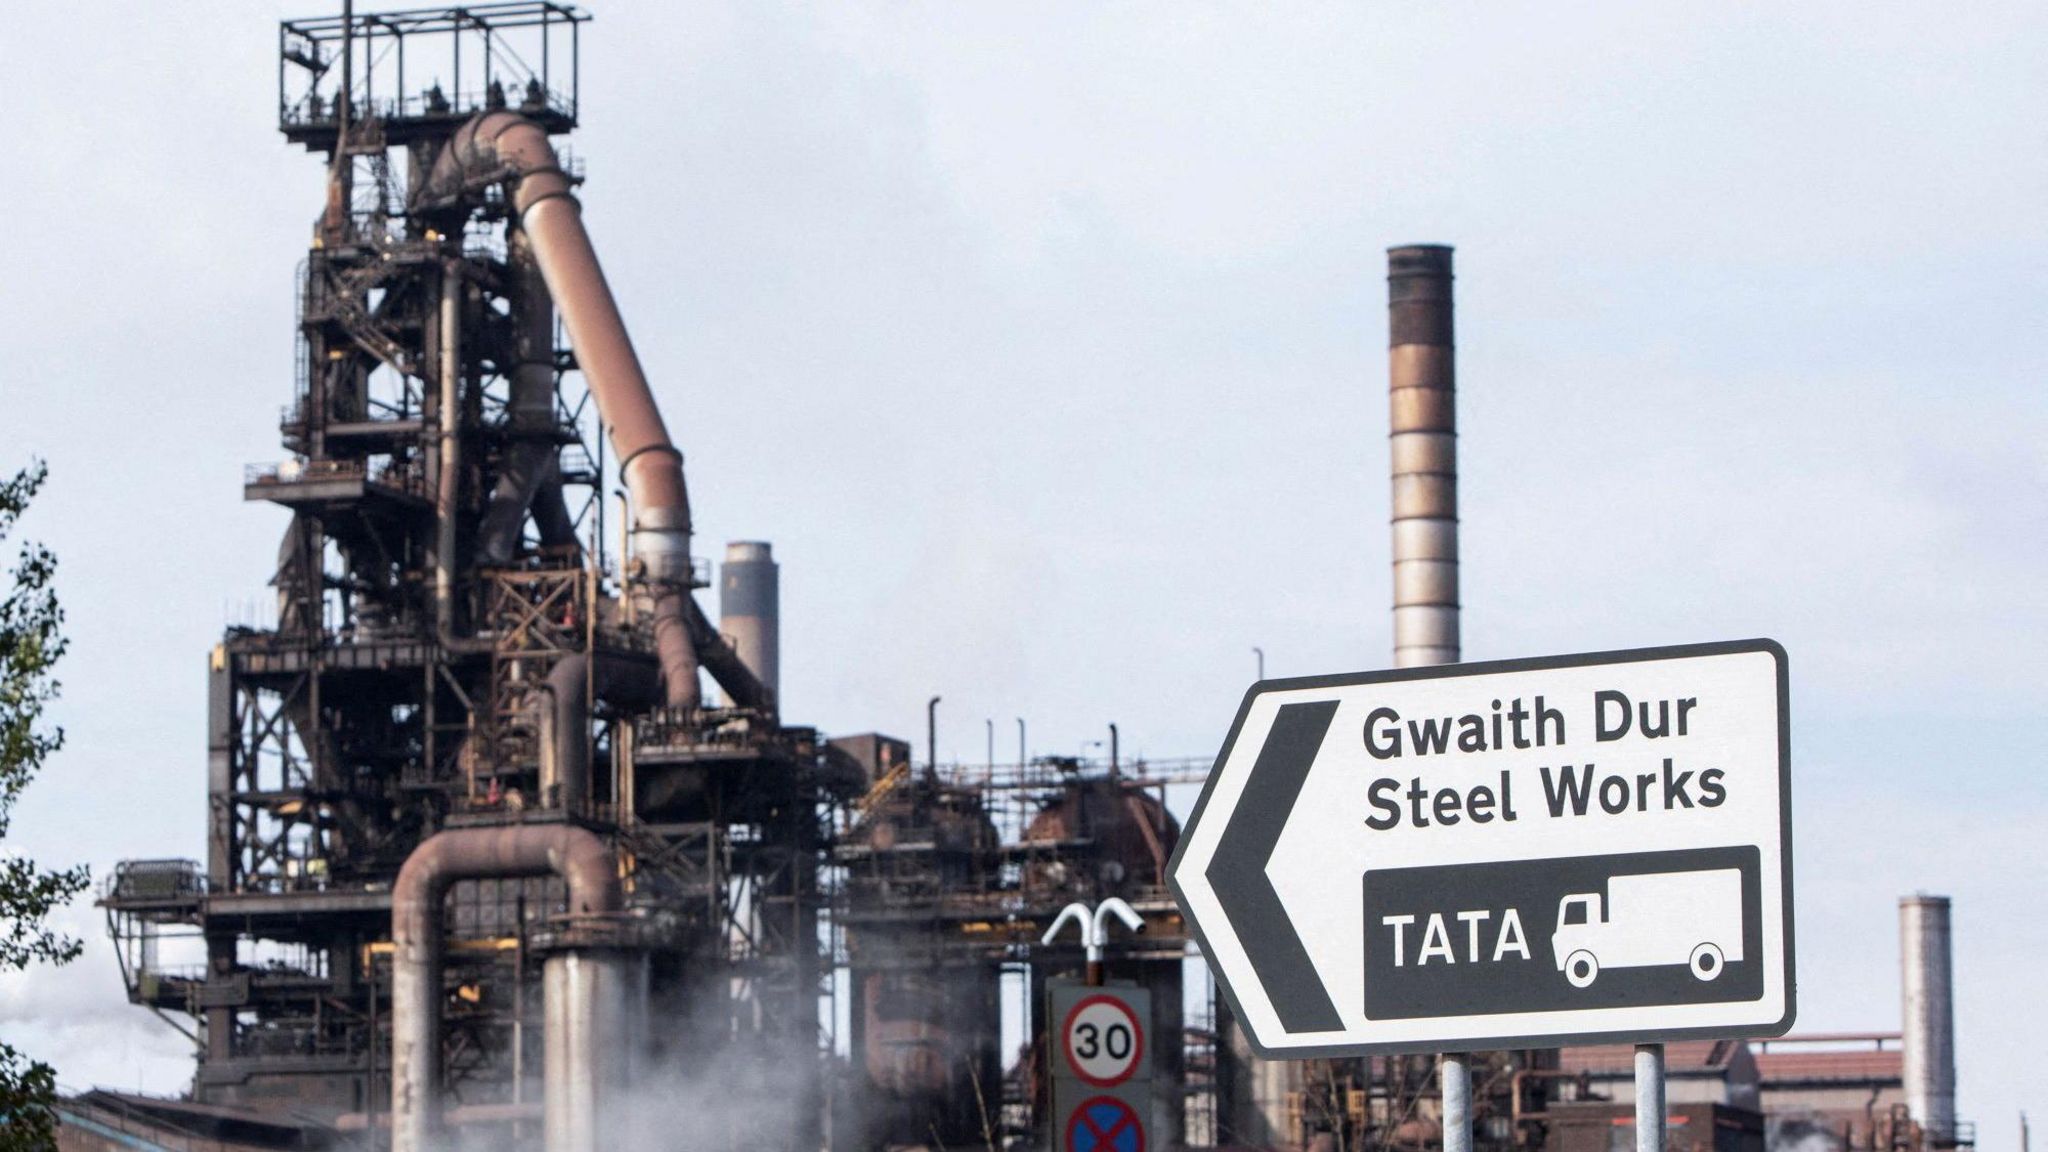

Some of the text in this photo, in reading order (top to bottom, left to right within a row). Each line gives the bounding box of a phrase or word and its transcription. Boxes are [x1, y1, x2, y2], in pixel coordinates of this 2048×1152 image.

[1363, 689, 1697, 760] Gwaith Dur
[1364, 758, 1727, 831] Steel Works
[1382, 908, 1532, 968] TATA
[1075, 1022, 1132, 1061] 30
